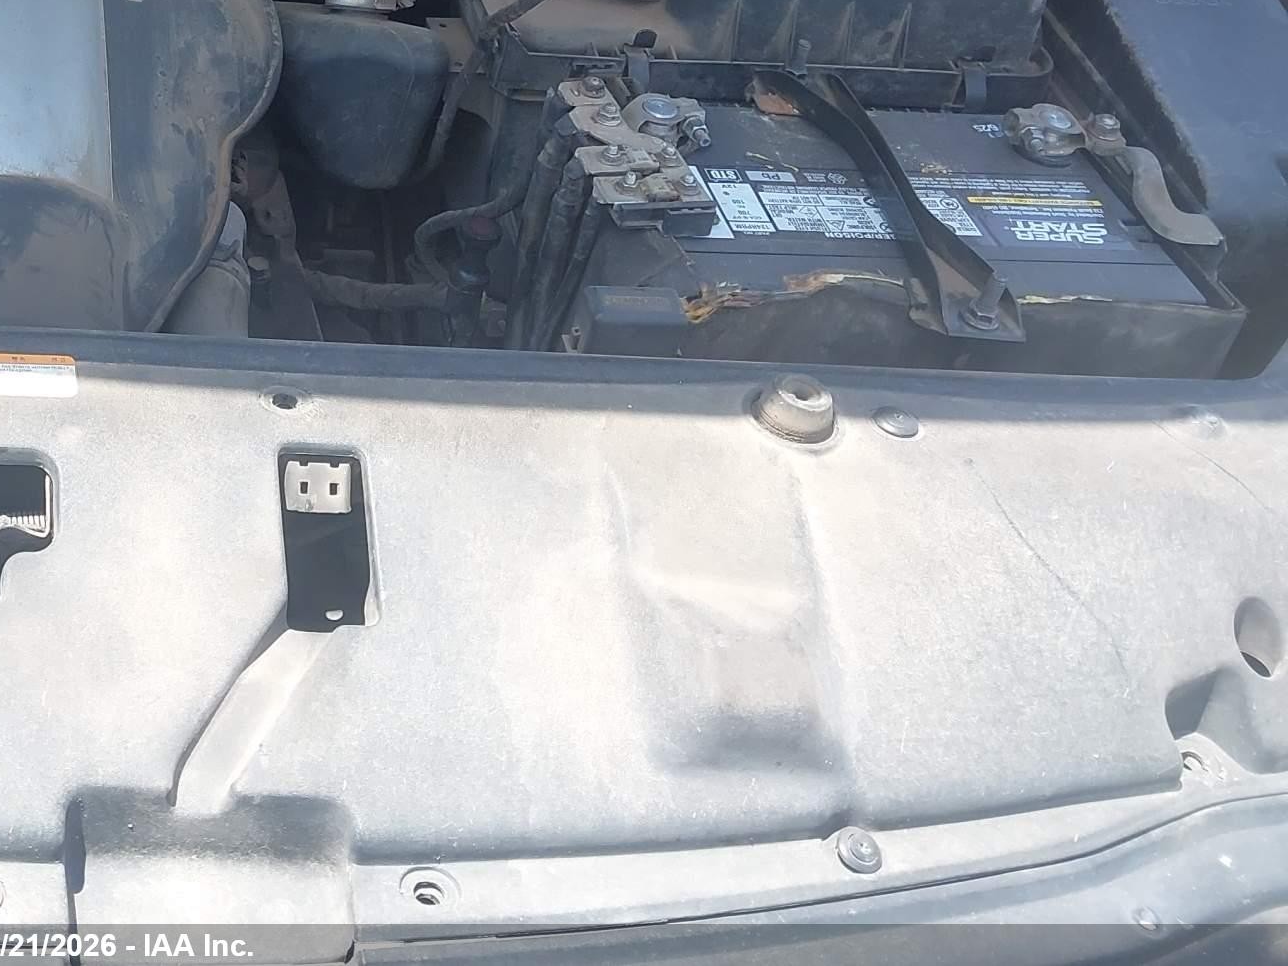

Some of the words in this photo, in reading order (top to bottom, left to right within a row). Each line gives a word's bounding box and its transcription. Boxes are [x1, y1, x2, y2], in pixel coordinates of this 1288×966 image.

[711, 170, 737, 179] STD
[761, 172, 781, 181] Pb
[1010, 221, 1108, 236] START
[1015, 230, 1105, 244] SUPER
